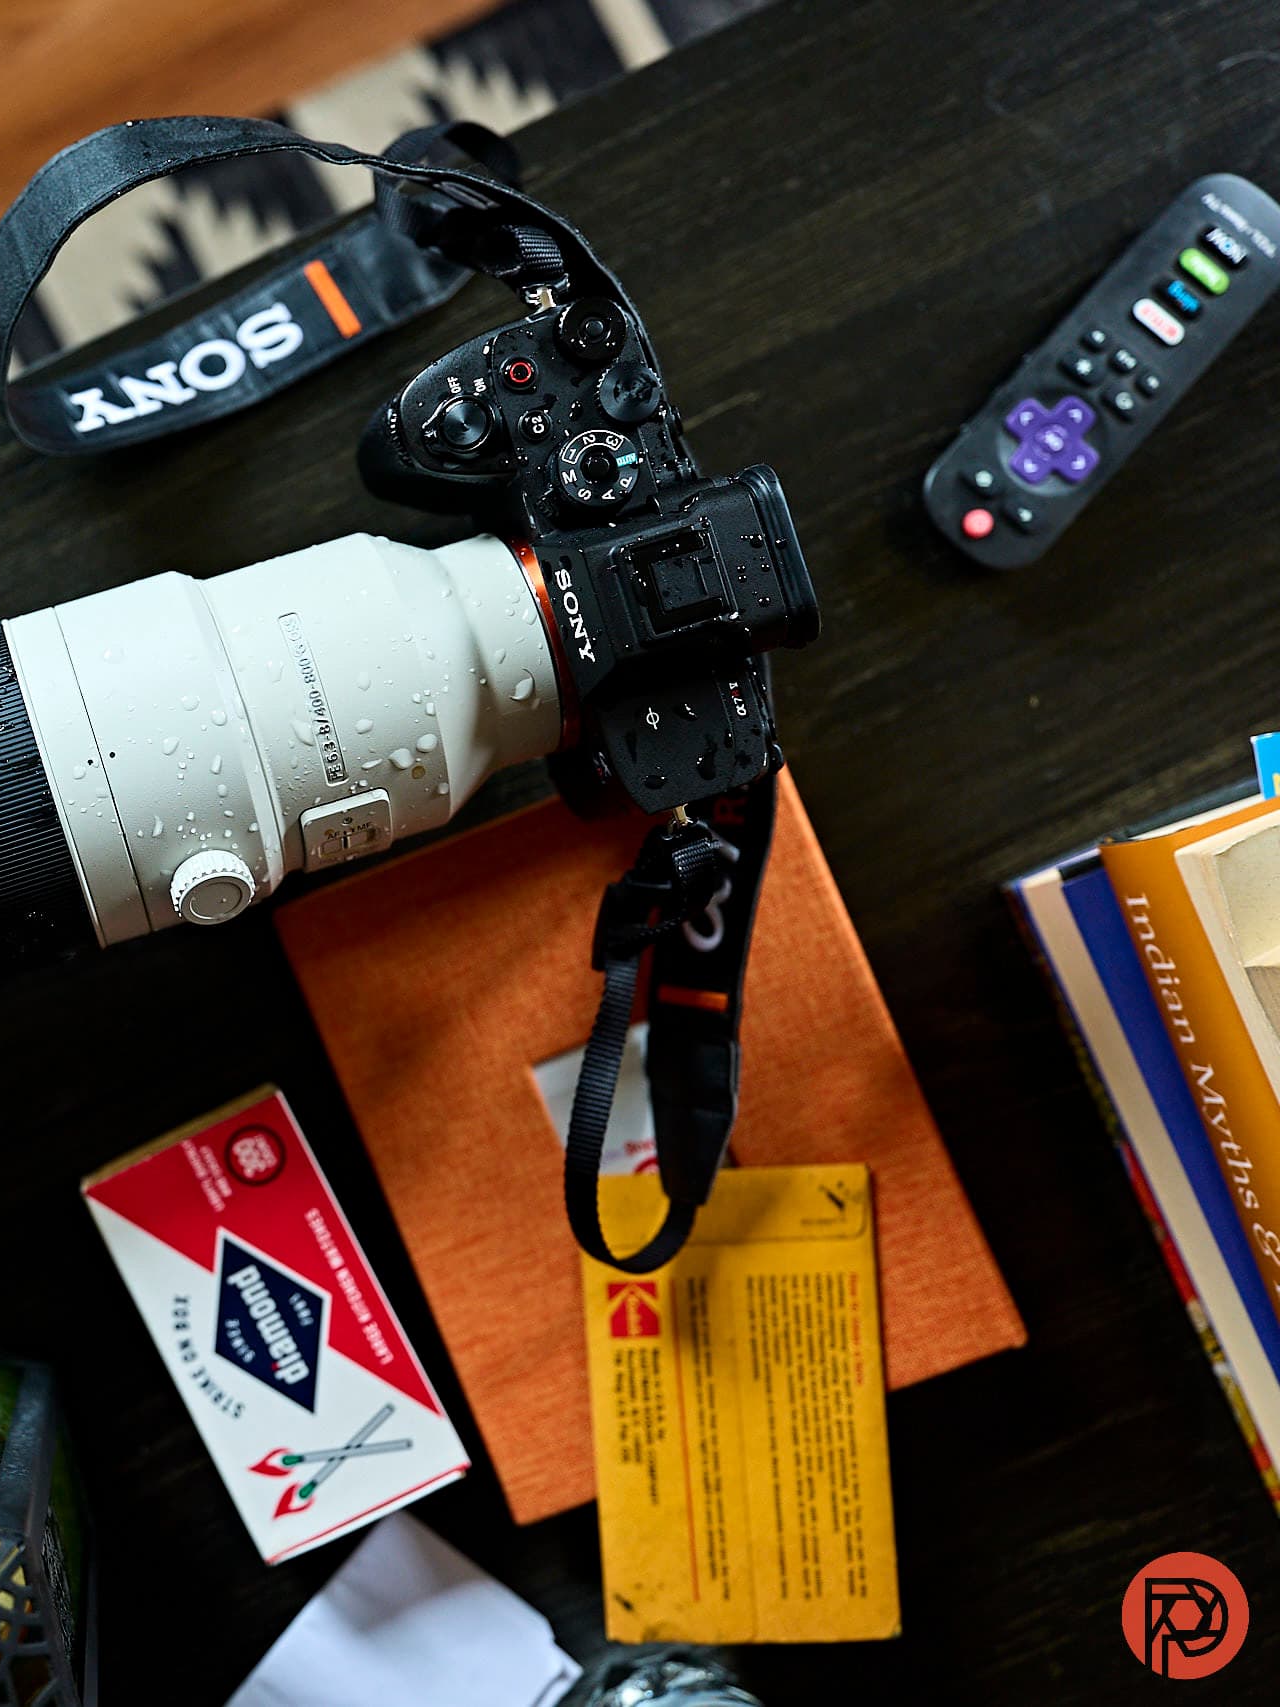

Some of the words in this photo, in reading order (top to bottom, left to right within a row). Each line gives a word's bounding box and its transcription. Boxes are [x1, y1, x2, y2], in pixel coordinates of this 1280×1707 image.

[67, 301, 305, 434] SONY
[447, 375, 461, 393] OFF
[473, 377, 486, 391] ON
[531, 415, 544, 433] C2
[568, 447, 577, 460] 1
[581, 433, 595, 444] 2
[605, 434, 618, 446] 3
[617, 453, 636, 466] AUTO
[561, 468, 577, 484] M
[577, 487, 591, 500] S
[600, 488, 615, 500] A
[619, 475, 632, 488] P
[554, 569, 596, 664] SONY
[1125, 892, 1196, 1045] Indian
[1190, 1061, 1262, 1211] Myths
[304, 1207, 345, 1270] MATCHES
[172, 1295, 190, 1331] BOX
[335, 1267, 372, 1324] KITCHEN
[226, 1264, 310, 1385] diamond
[362, 1321, 394, 1365] LARGE
[179, 1339, 198, 1362] ON
[191, 1366, 246, 1420] STRIKE
